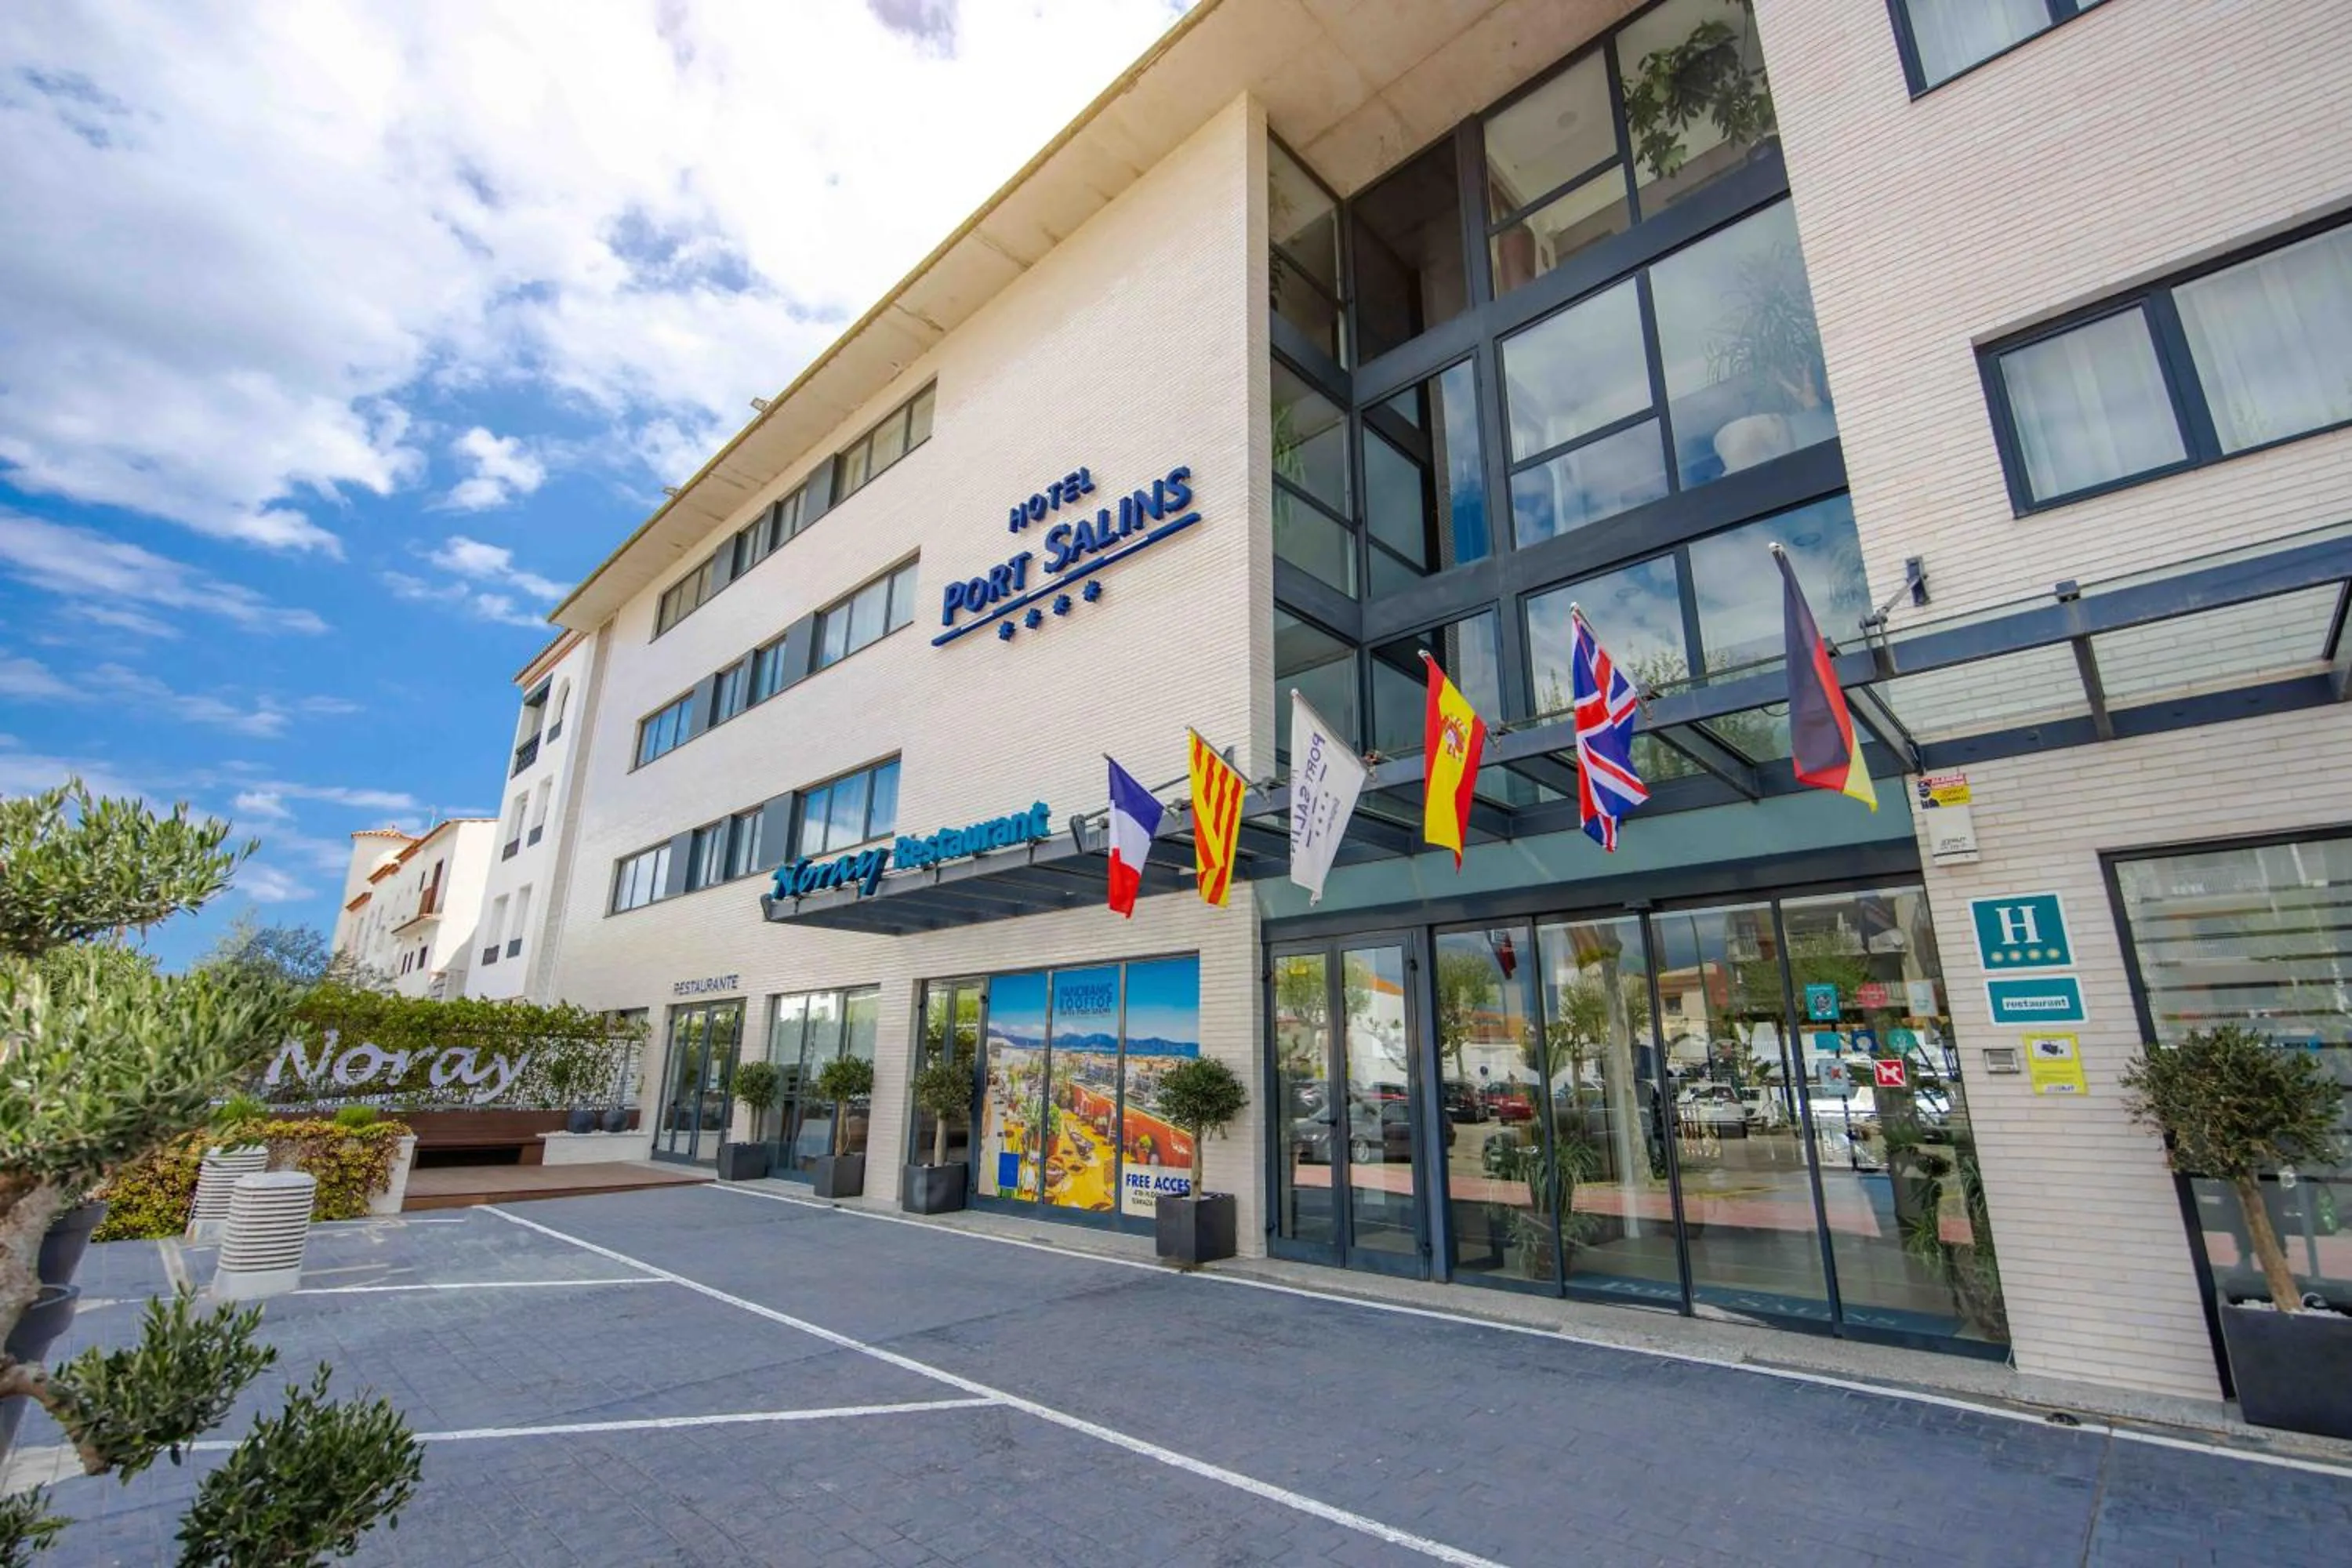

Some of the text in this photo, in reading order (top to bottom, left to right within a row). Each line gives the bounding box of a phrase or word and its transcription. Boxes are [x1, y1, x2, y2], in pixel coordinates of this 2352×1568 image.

[1008, 466, 1095, 533] HOTEL
[942, 466, 1192, 626] PORT SALINS
[772, 800, 1052, 899] Noray Restaurant
[1995, 906, 2042, 944] H
[673, 974, 739, 995] RESTAURANTE
[2006, 998, 2067, 1008] restaurant
[265, 1029, 532, 1105] Noray
[1126, 1174, 1192, 1192] FREE ACCES
